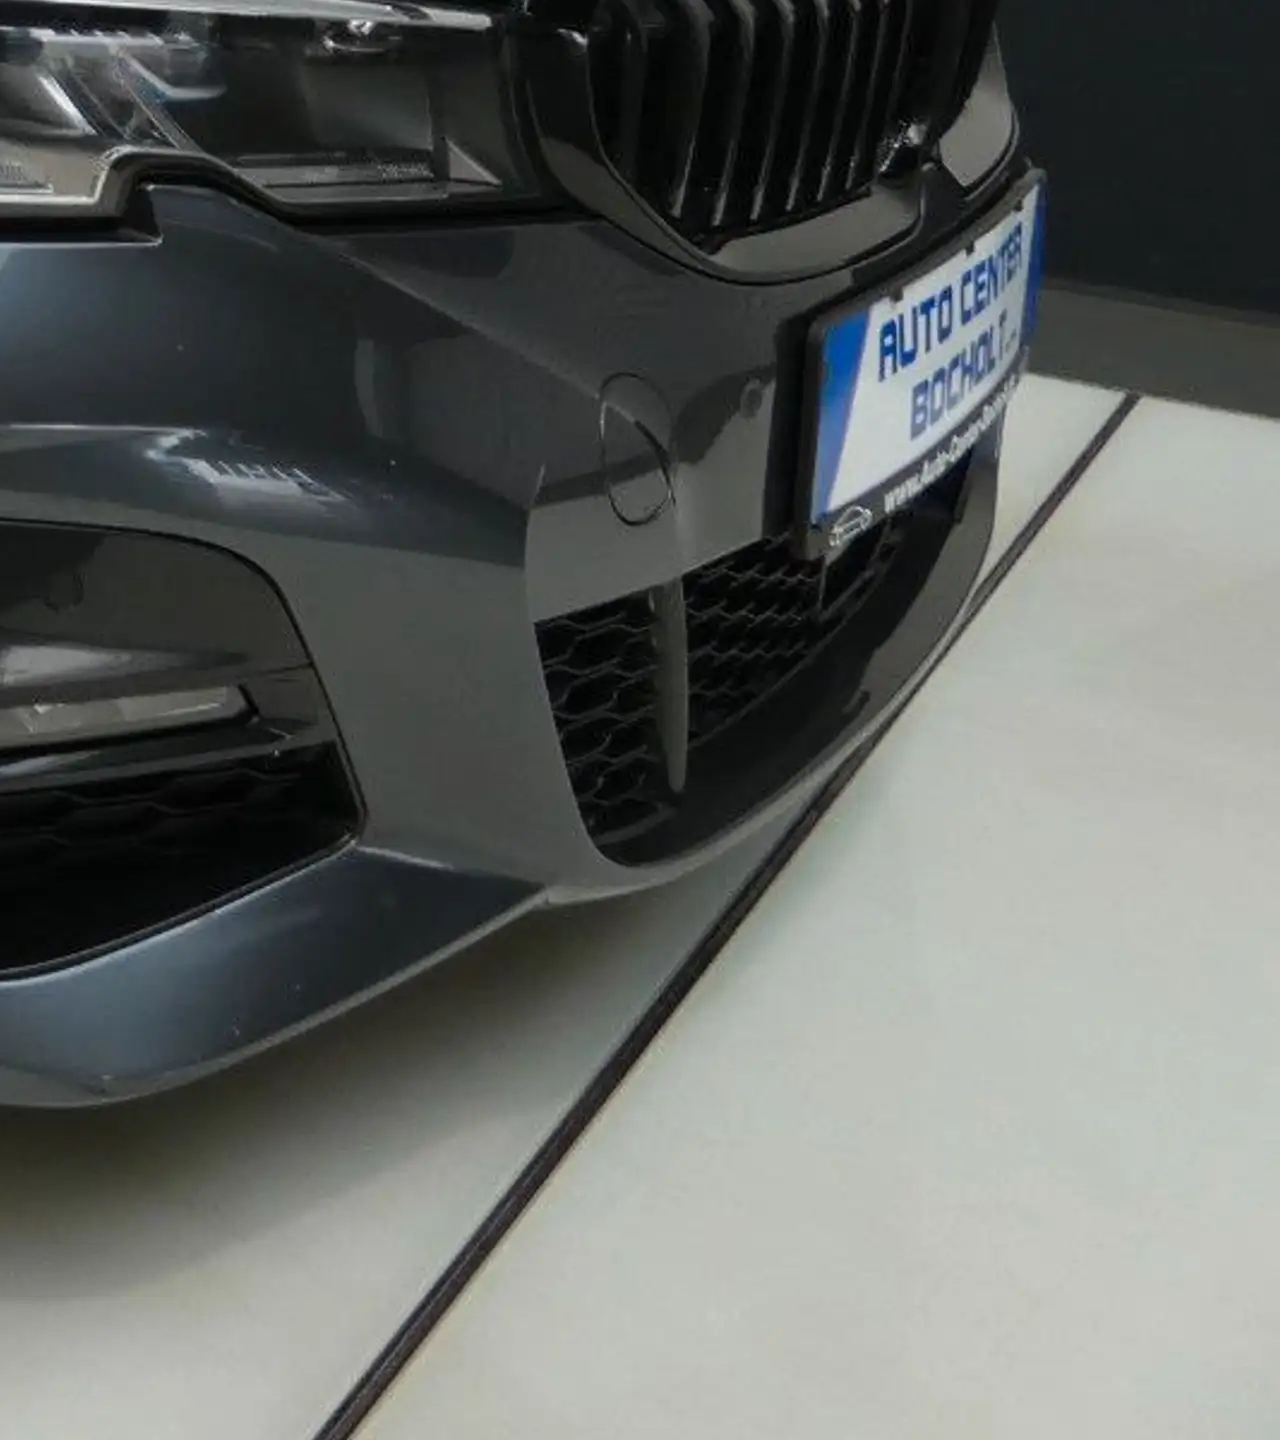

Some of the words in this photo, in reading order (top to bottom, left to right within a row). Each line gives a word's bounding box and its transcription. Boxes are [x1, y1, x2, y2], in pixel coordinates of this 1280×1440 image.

[878, 284, 953, 383] AUTO
[960, 221, 1022, 327] CENTER
[910, 308, 1007, 441] BOCHOLT
